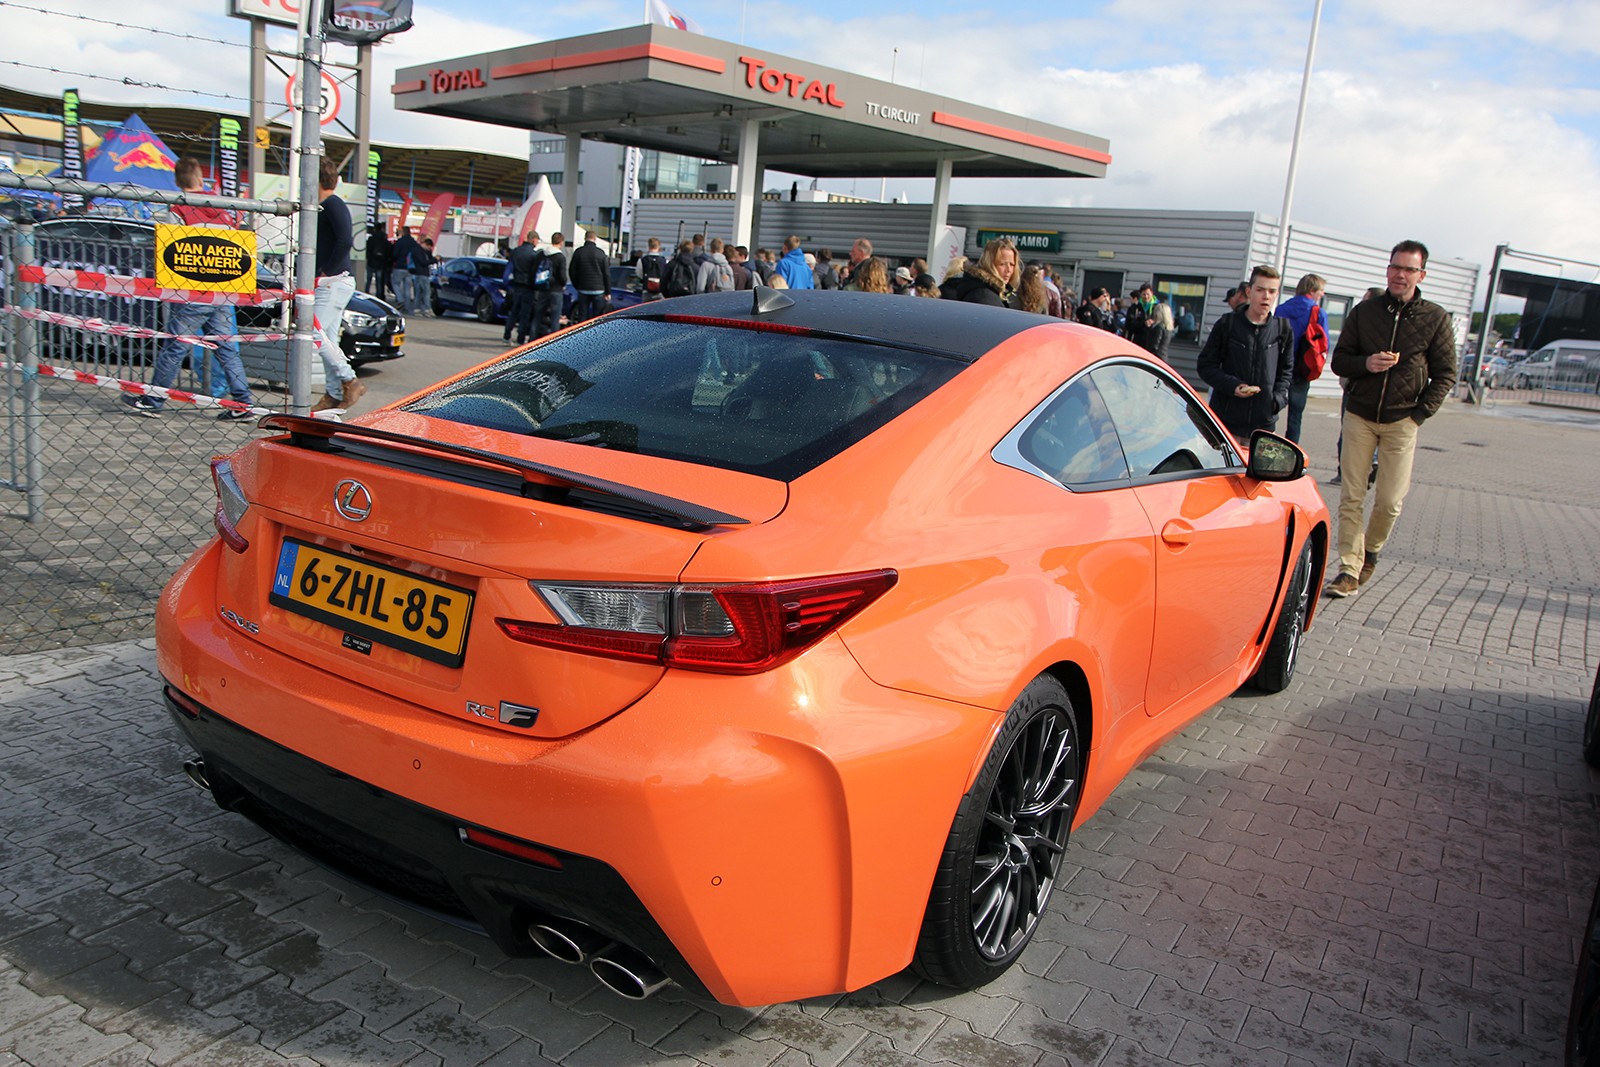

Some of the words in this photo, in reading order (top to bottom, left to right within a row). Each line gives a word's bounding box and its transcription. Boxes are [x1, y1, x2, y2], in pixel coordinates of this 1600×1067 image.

[428, 67, 487, 94] TOTAL
[740, 56, 846, 108] TOTAL
[865, 101, 880, 116] TT
[880, 105, 920, 125] CIRCUIT
[174, 241, 203, 255] VAN
[206, 245, 243, 258] AKEN
[173, 253, 242, 269] HEKWERK
[277, 573, 289, 588] NL
[300, 557, 452, 640] 6-ZHL-85
[465, 700, 496, 720] RC
